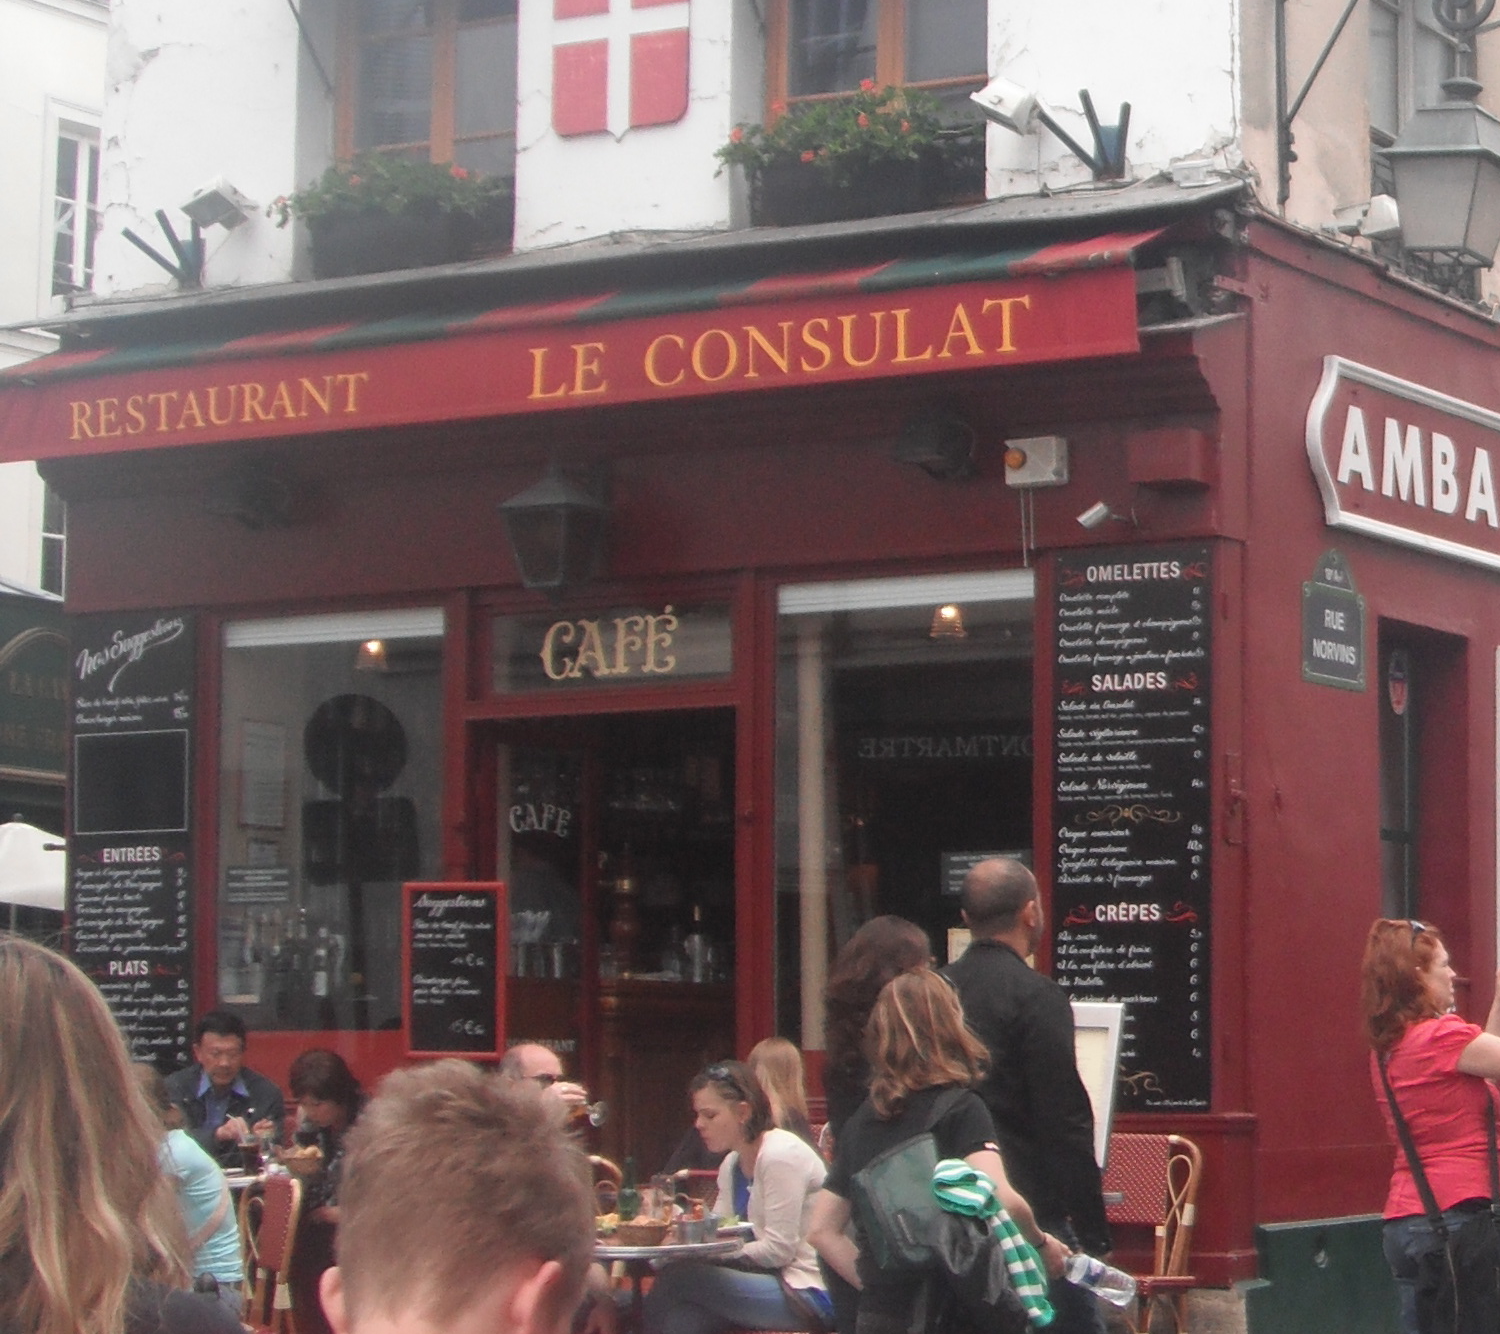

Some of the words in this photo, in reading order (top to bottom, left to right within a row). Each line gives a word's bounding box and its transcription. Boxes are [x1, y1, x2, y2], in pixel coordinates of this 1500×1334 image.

[69, 369, 371, 442] RESTAURANT
[527, 341, 607, 402] LE
[642, 293, 1032, 387] CONSULAT
[1086, 561, 1181, 583] OMELETTES
[1324, 609, 1345, 632] RUE
[109, 617, 185, 664] Suggestions
[539, 605, 680, 680] CAFÉ
[1312, 638, 1357, 666] NORVINS
[1091, 671, 1168, 692] SALADES
[102, 845, 161, 864] ENTRÉES
[413, 893, 487, 917] Suggestions
[1095, 901, 1162, 923] CRÊPES
[1190, 941, 1200, 953] 6
[109, 960, 149, 976] PLATS
[1189, 957, 1199, 969] 6
[1189, 974, 1199, 986] 6
[1189, 991, 1199, 1003] 6
[1190, 1028, 1199, 1040] 6
